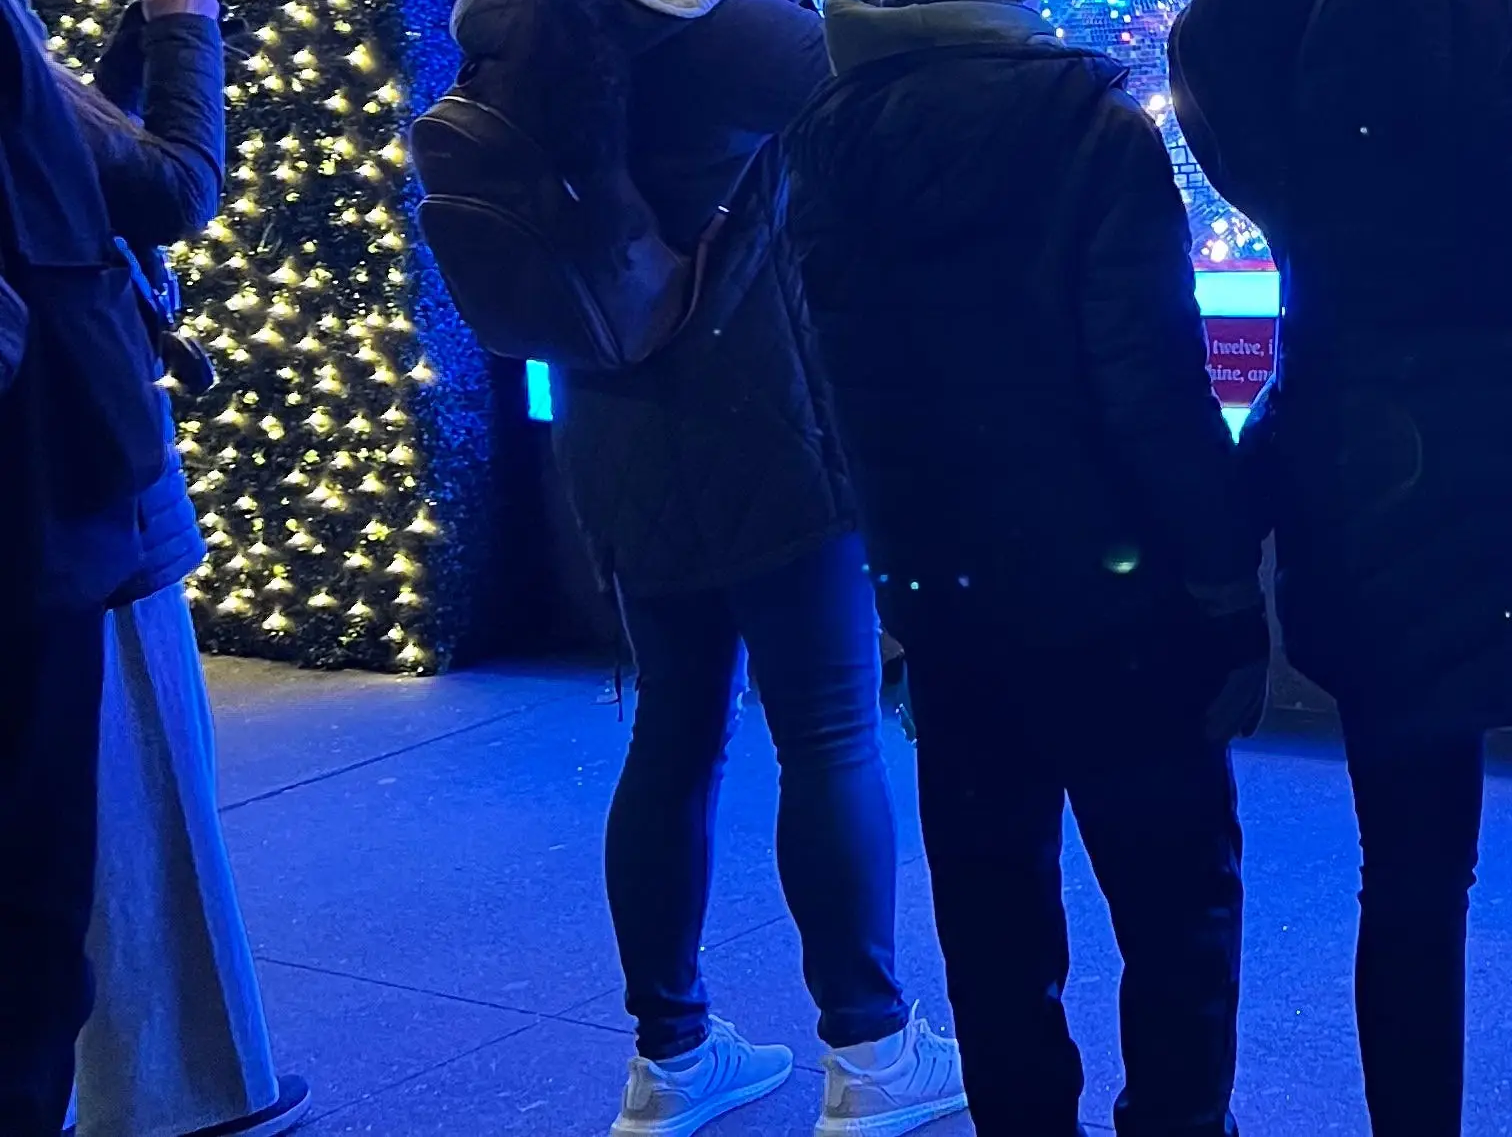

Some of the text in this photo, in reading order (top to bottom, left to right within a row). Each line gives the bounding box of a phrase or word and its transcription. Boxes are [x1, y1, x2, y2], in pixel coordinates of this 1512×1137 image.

[1212, 338, 1265, 357] twelve,
[1205, 363, 1272, 384] hine, an
